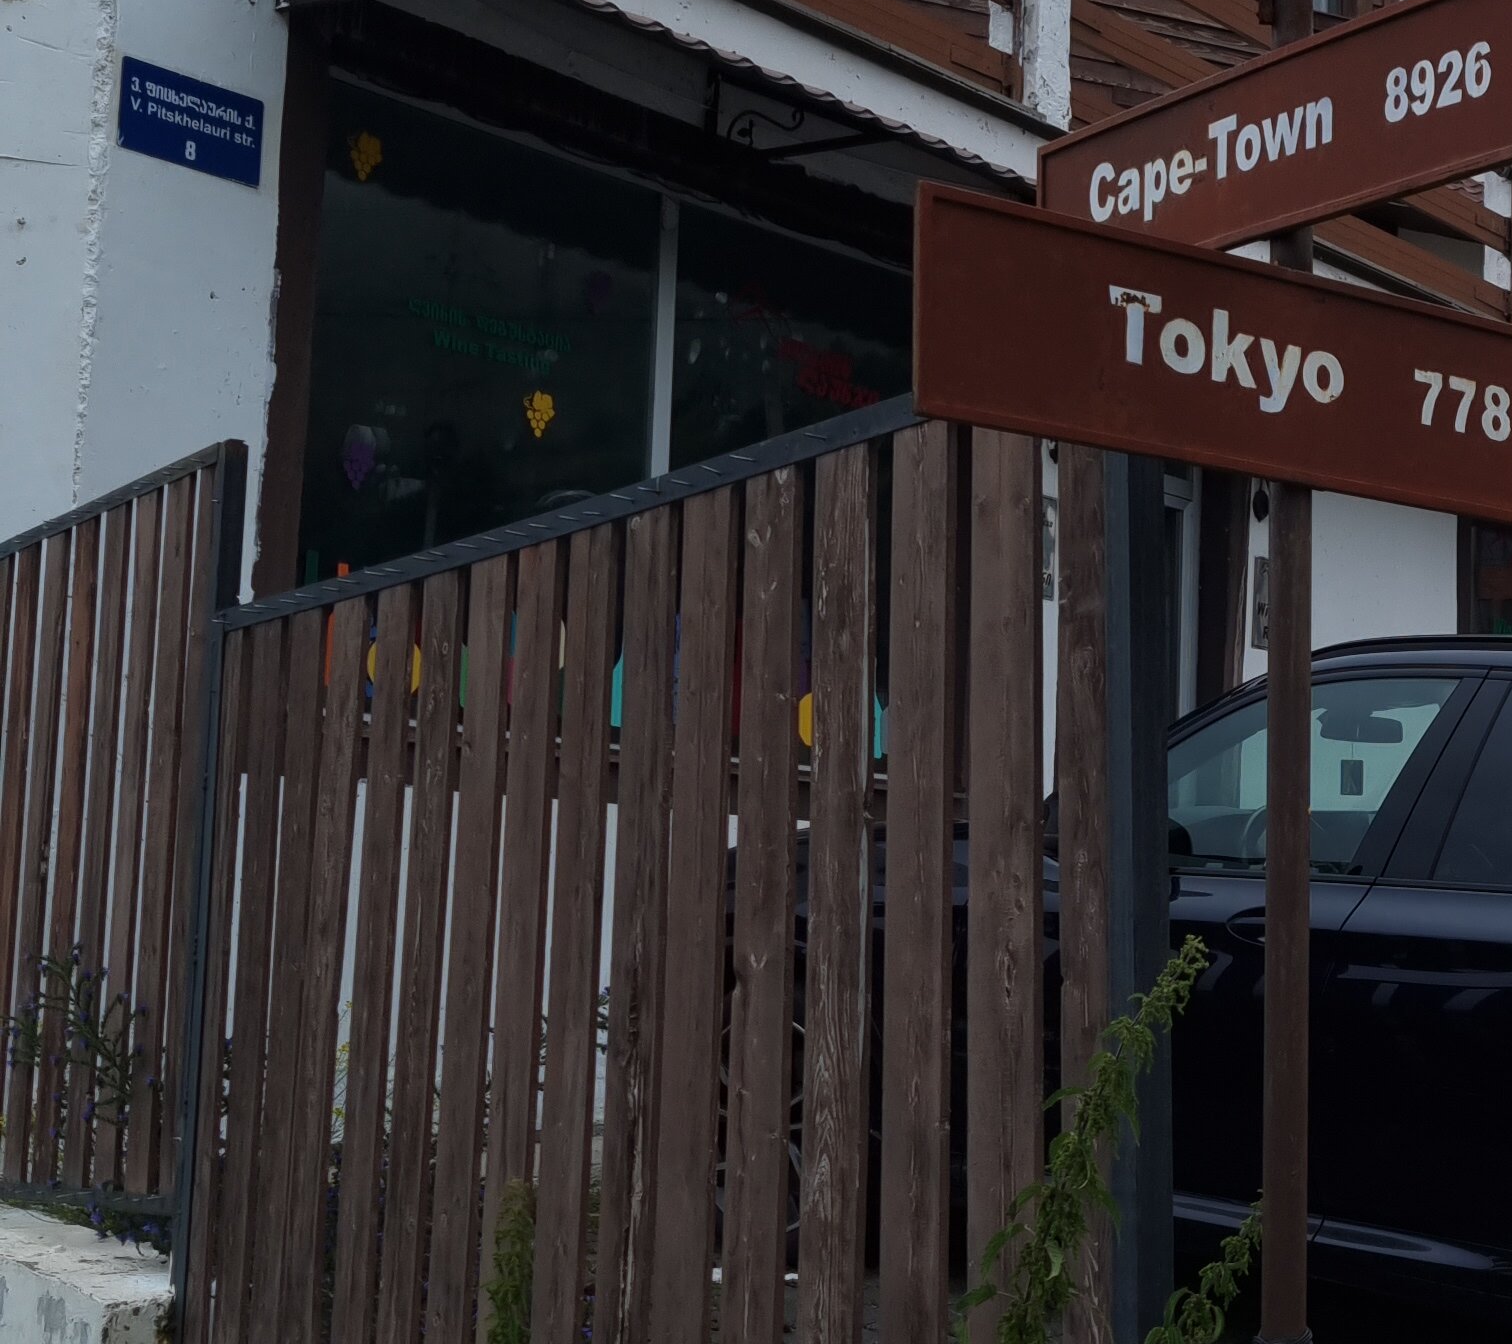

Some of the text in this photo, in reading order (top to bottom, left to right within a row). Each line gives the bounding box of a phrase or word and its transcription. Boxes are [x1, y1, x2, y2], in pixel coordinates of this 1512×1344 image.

[130, 96, 256, 149] V. Pitskhelauri str.
[184, 140, 196, 161] 8
[1089, 41, 1492, 223] Cape-Town 8926
[1108, 285, 1345, 413] Tokyo
